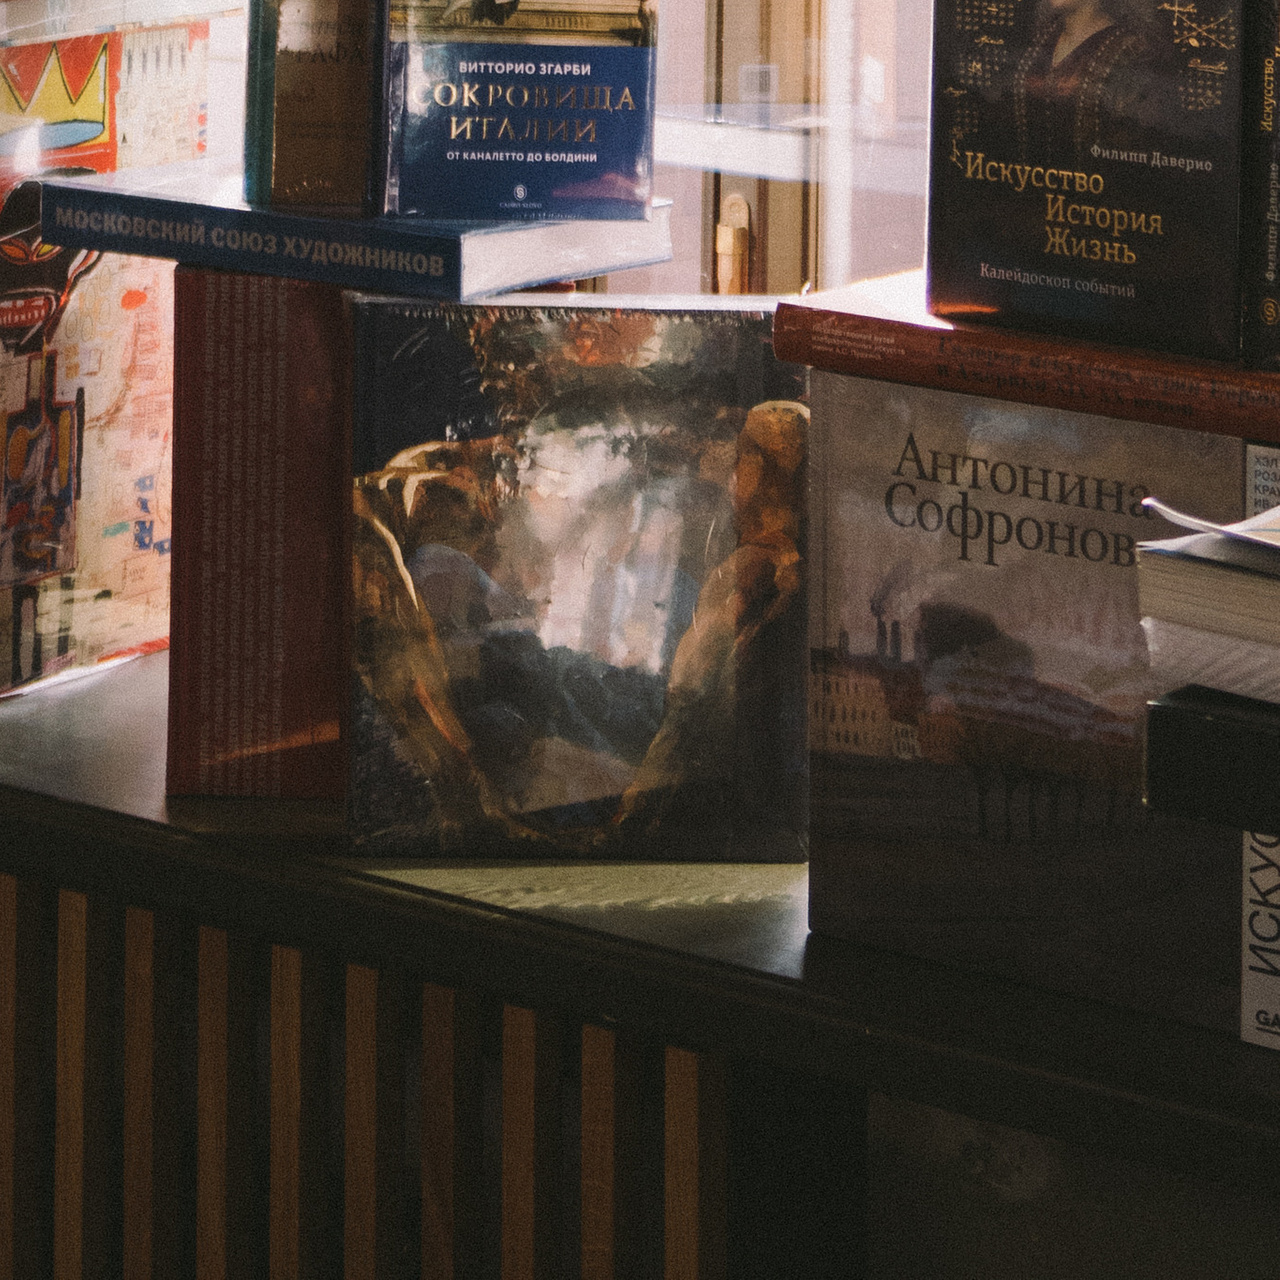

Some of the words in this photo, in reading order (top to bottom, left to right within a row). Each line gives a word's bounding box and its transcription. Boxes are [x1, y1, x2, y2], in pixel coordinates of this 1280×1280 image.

[459, 61, 536, 75] ВИТТОРИО
[539, 63, 591, 75] ЗГАРБИ
[413, 82, 636, 112] СОКРОВИЩА
[1260, 58, 1275, 132] Искусство
[450, 115, 597, 142] ИТАЛИИ
[446, 151, 460, 160] ОТ
[463, 151, 524, 162] КАНАЛЕТТО
[527, 153, 542, 163] ДО
[545, 152, 597, 163] БОЛДИНИ
[965, 151, 1105, 195] Искусство
[1090, 143, 1148, 164] Филипп
[1151, 151, 1213, 173] Даверио
[1045, 193, 1164, 237] История
[56, 207, 206, 244] МОСКОВСКИЙ
[211, 227, 277, 254] СОЮЗ
[283, 236, 444, 277] ХУДОЖНИКОВ
[1044, 225, 1137, 265] Жизнь
[980, 262, 1071, 289] Калейдоскоп
[1074, 279, 1136, 299] событий
[892, 431, 1153, 521] Антонина
[1254, 455, 1278, 468] ХЭЛ
[885, 481, 1136, 568] Софронов
